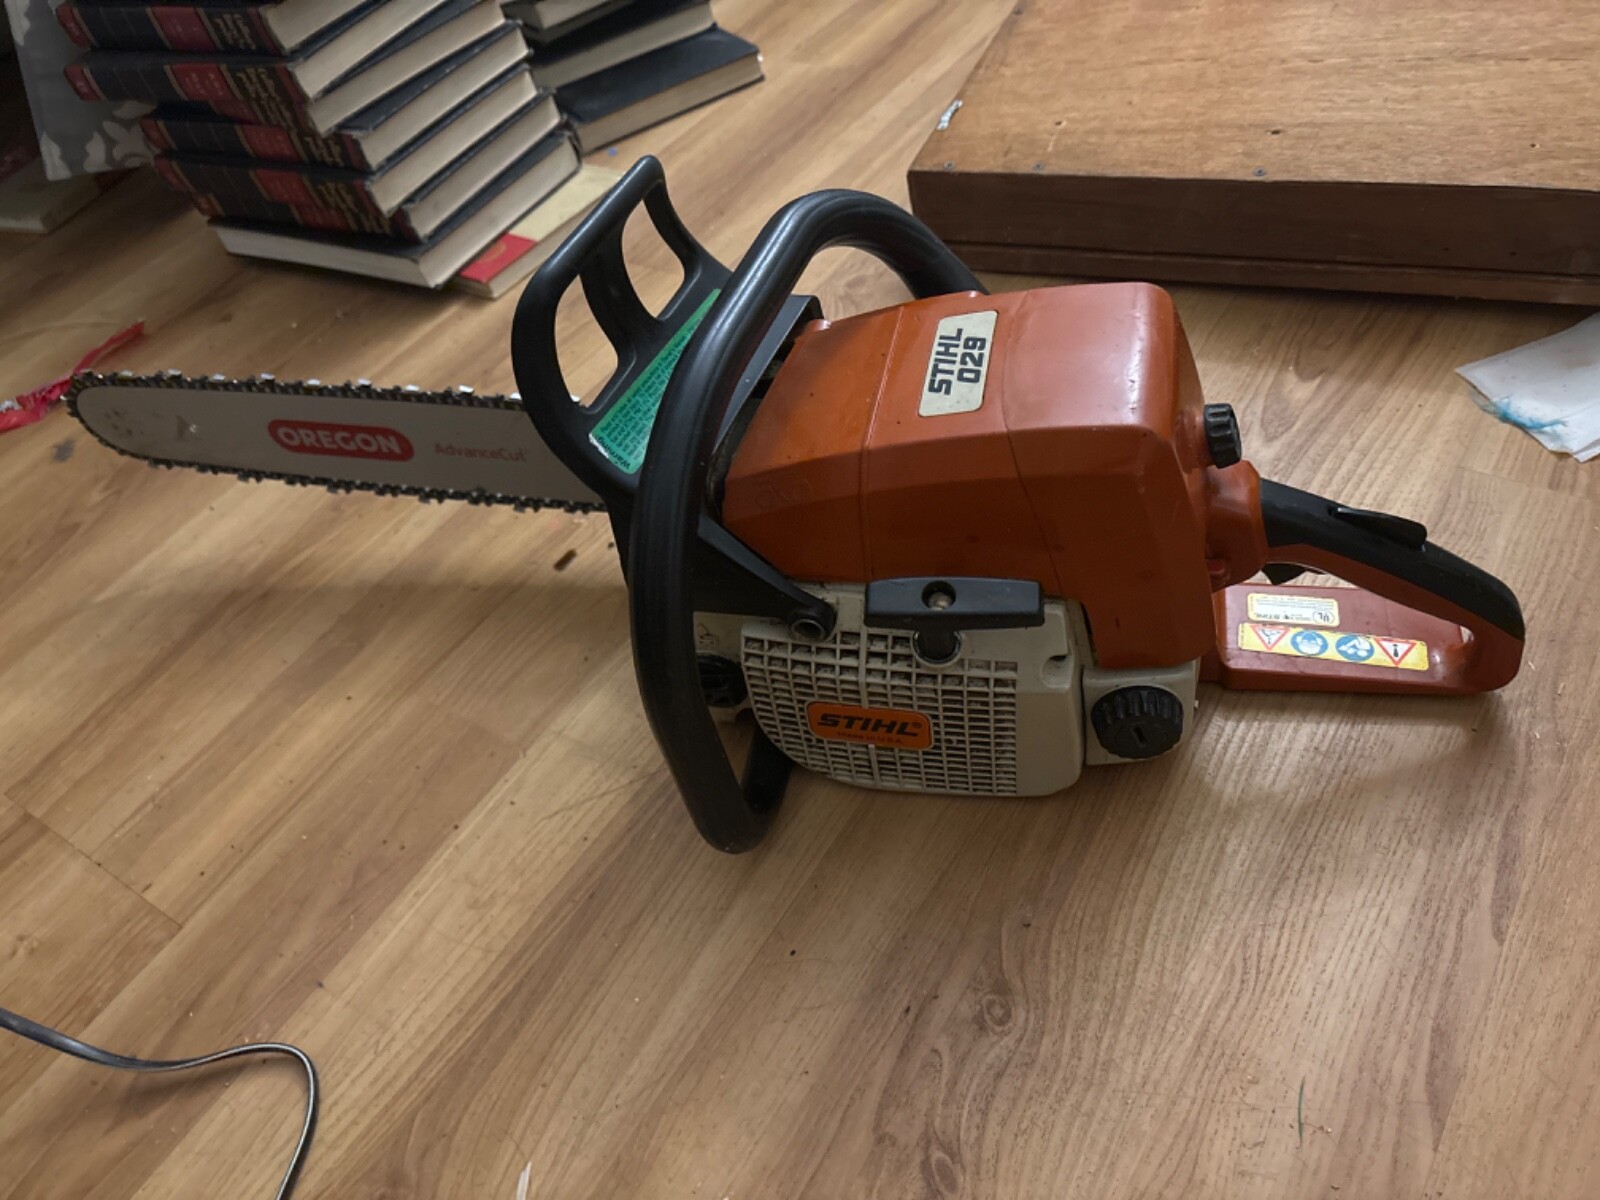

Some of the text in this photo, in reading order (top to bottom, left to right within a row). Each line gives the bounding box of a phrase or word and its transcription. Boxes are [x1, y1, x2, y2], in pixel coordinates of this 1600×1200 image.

[928, 327, 964, 396] STIHL
[957, 336, 987, 384] 029
[276, 426, 401, 455] OREGON
[434, 442, 528, 462] AdvanceCut
[817, 713, 919, 738] STIHL
